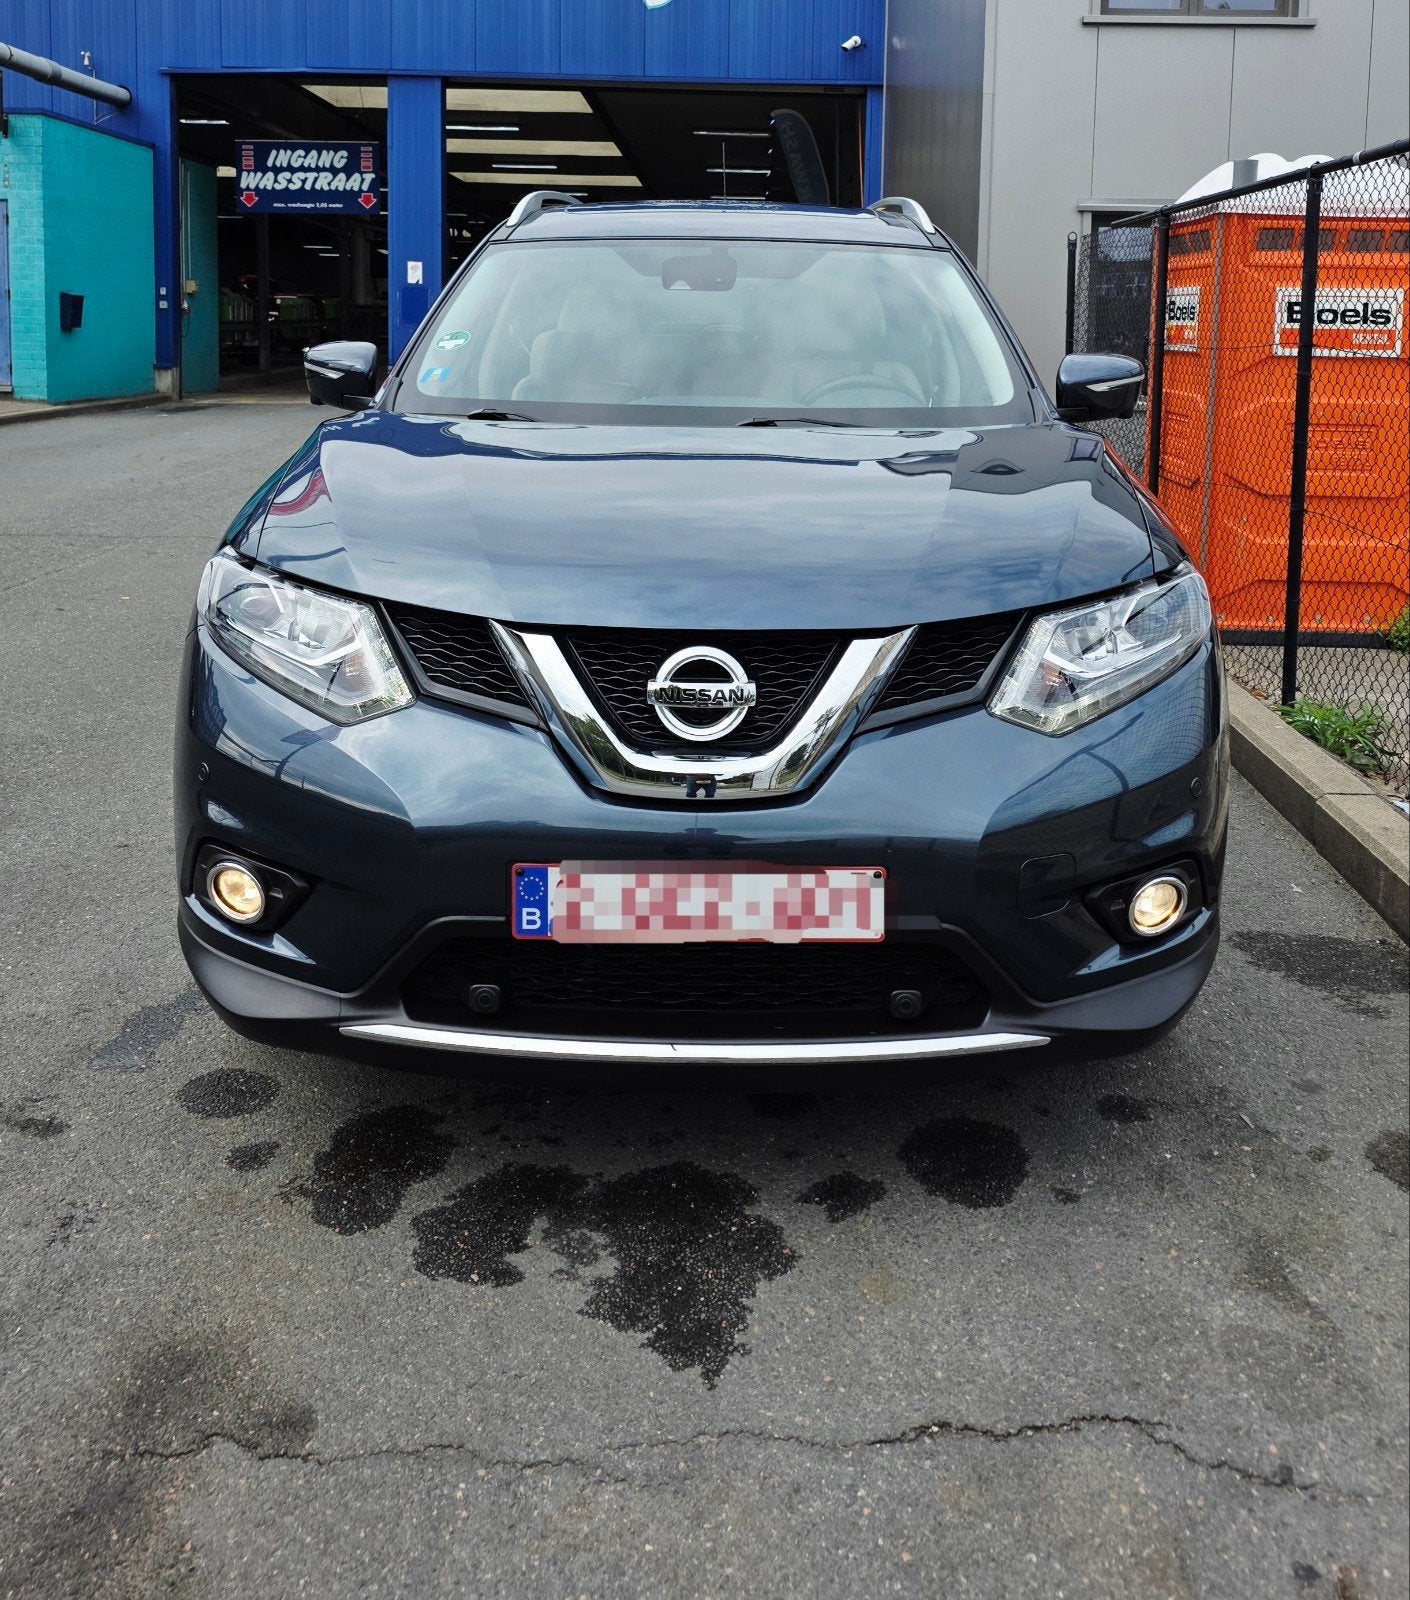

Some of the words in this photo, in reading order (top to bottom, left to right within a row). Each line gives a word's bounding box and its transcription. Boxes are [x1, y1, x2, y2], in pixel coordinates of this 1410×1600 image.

[266, 149, 348, 169] INGANG
[239, 171, 376, 192] WASSTRAAT
[1168, 300, 1197, 321] Boels
[658, 687, 745, 703] NISSAN
[521, 907, 542, 930] B
